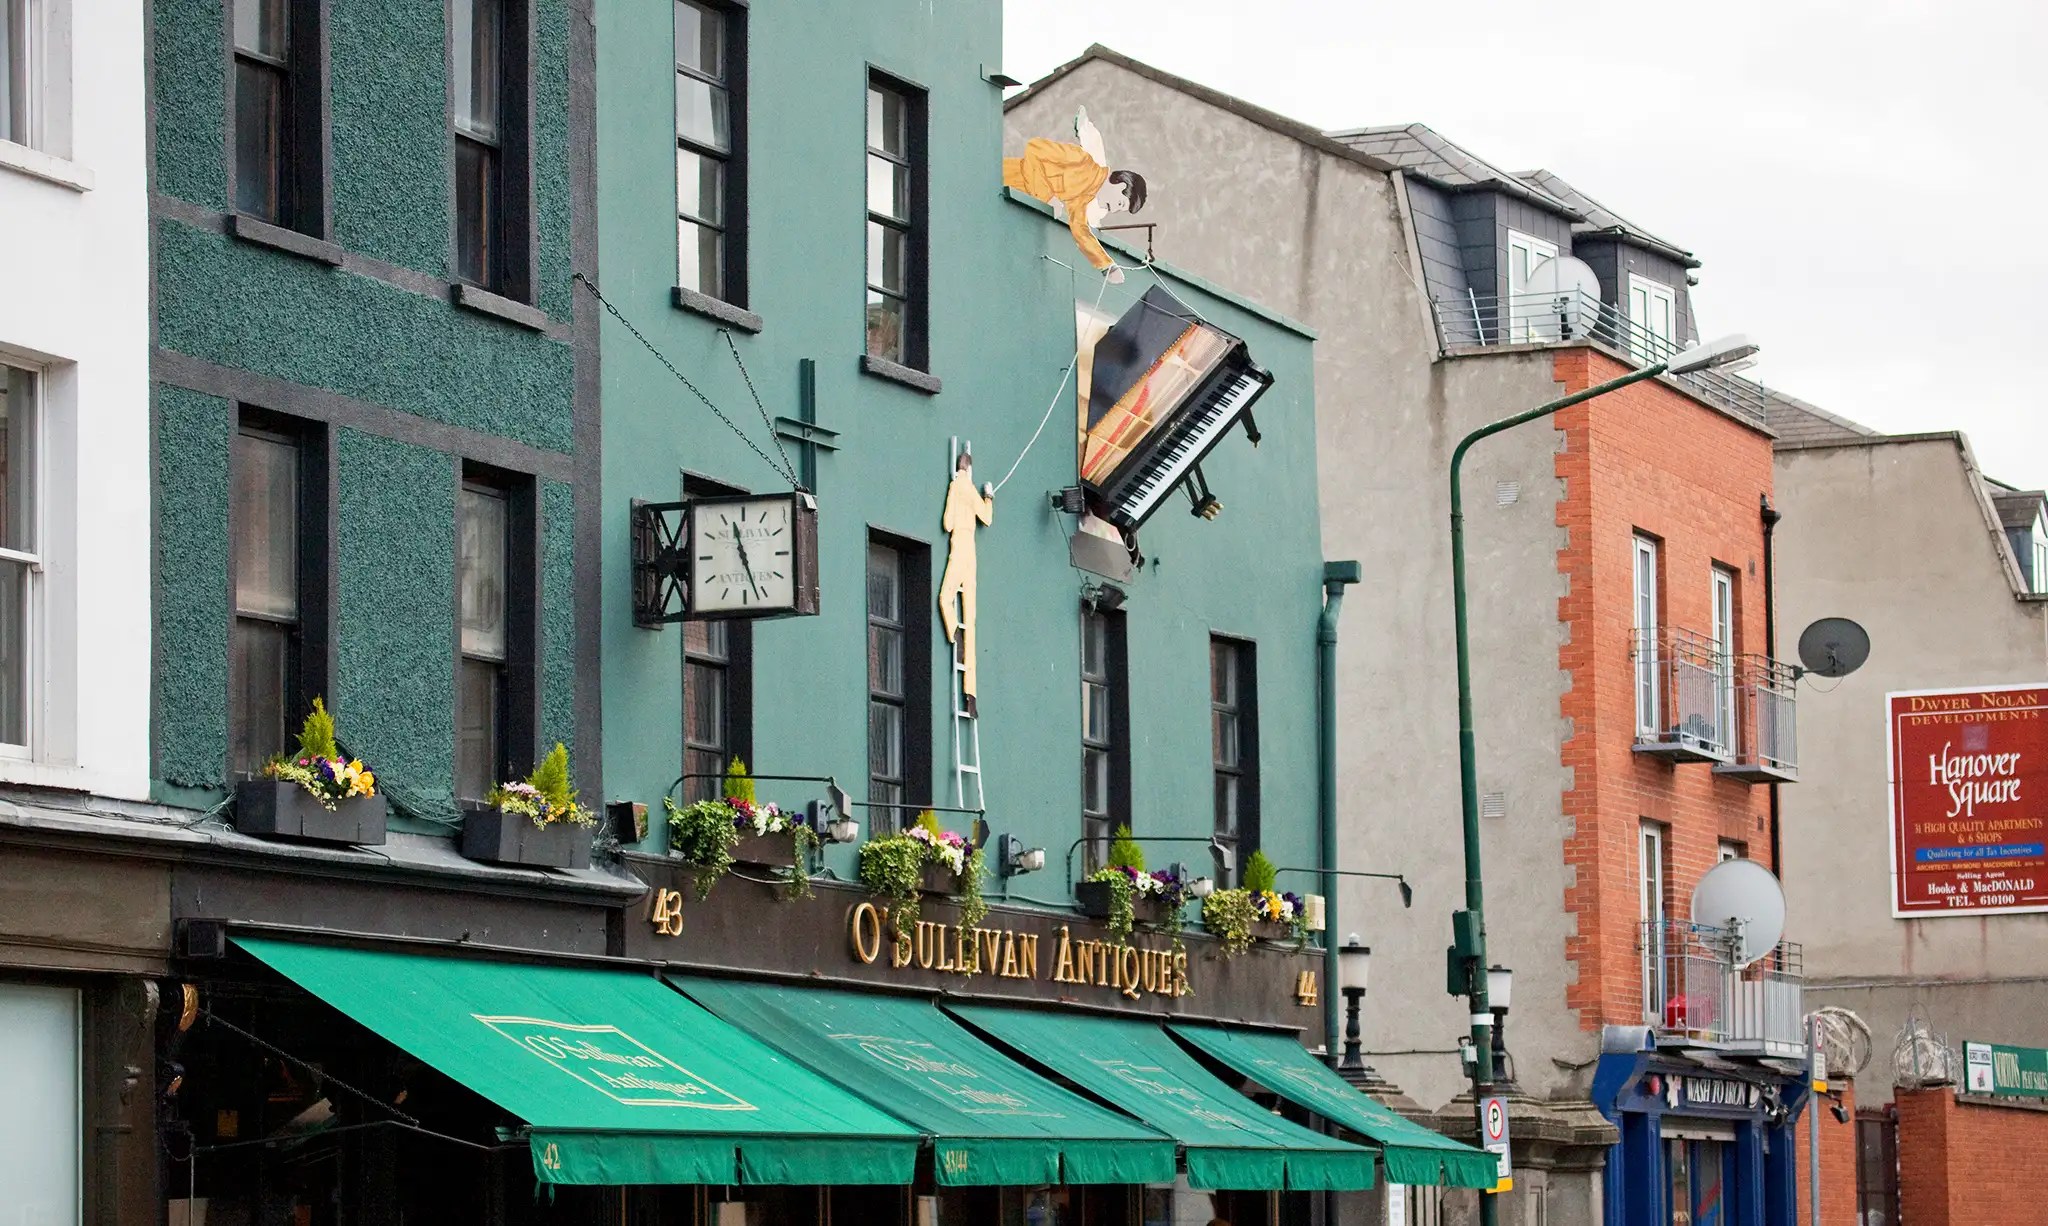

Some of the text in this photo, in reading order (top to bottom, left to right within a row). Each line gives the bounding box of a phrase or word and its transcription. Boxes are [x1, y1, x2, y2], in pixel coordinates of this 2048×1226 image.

[1910, 692, 2038, 712] DWYER NOLAN
[1911, 709, 2040, 726] DEVELOPMENTS
[1928, 741, 2021, 786] Hanover
[1946, 777, 2022, 818] Square
[1924, 821, 1946, 834] HIGH
[1949, 820, 1985, 834] QUALITY
[1988, 818, 2043, 831] APARTMENTS
[1957, 834, 1965, 843] &
[1975, 831, 2003, 843] SHOPS
[1927, 847, 1962, 859] Qualifying
[1963, 847, 1974, 858] for
[1975, 846, 1985, 857] all
[2000, 845, 2033, 856] Incentives
[1957, 870, 2006, 881] Selling Agent
[1928, 879, 2035, 895] Hooke & MacDONALD
[1946, 894, 2016, 908] TEL. 610100
[652, 887, 684, 937] 43
[852, 902, 1188, 1000] O'SULLIVAN ANTIQUES
[1298, 970, 1318, 1006] 44
[1687, 1078, 1747, 1106] WASH TO IRON
[543, 1143, 562, 1171] 42
